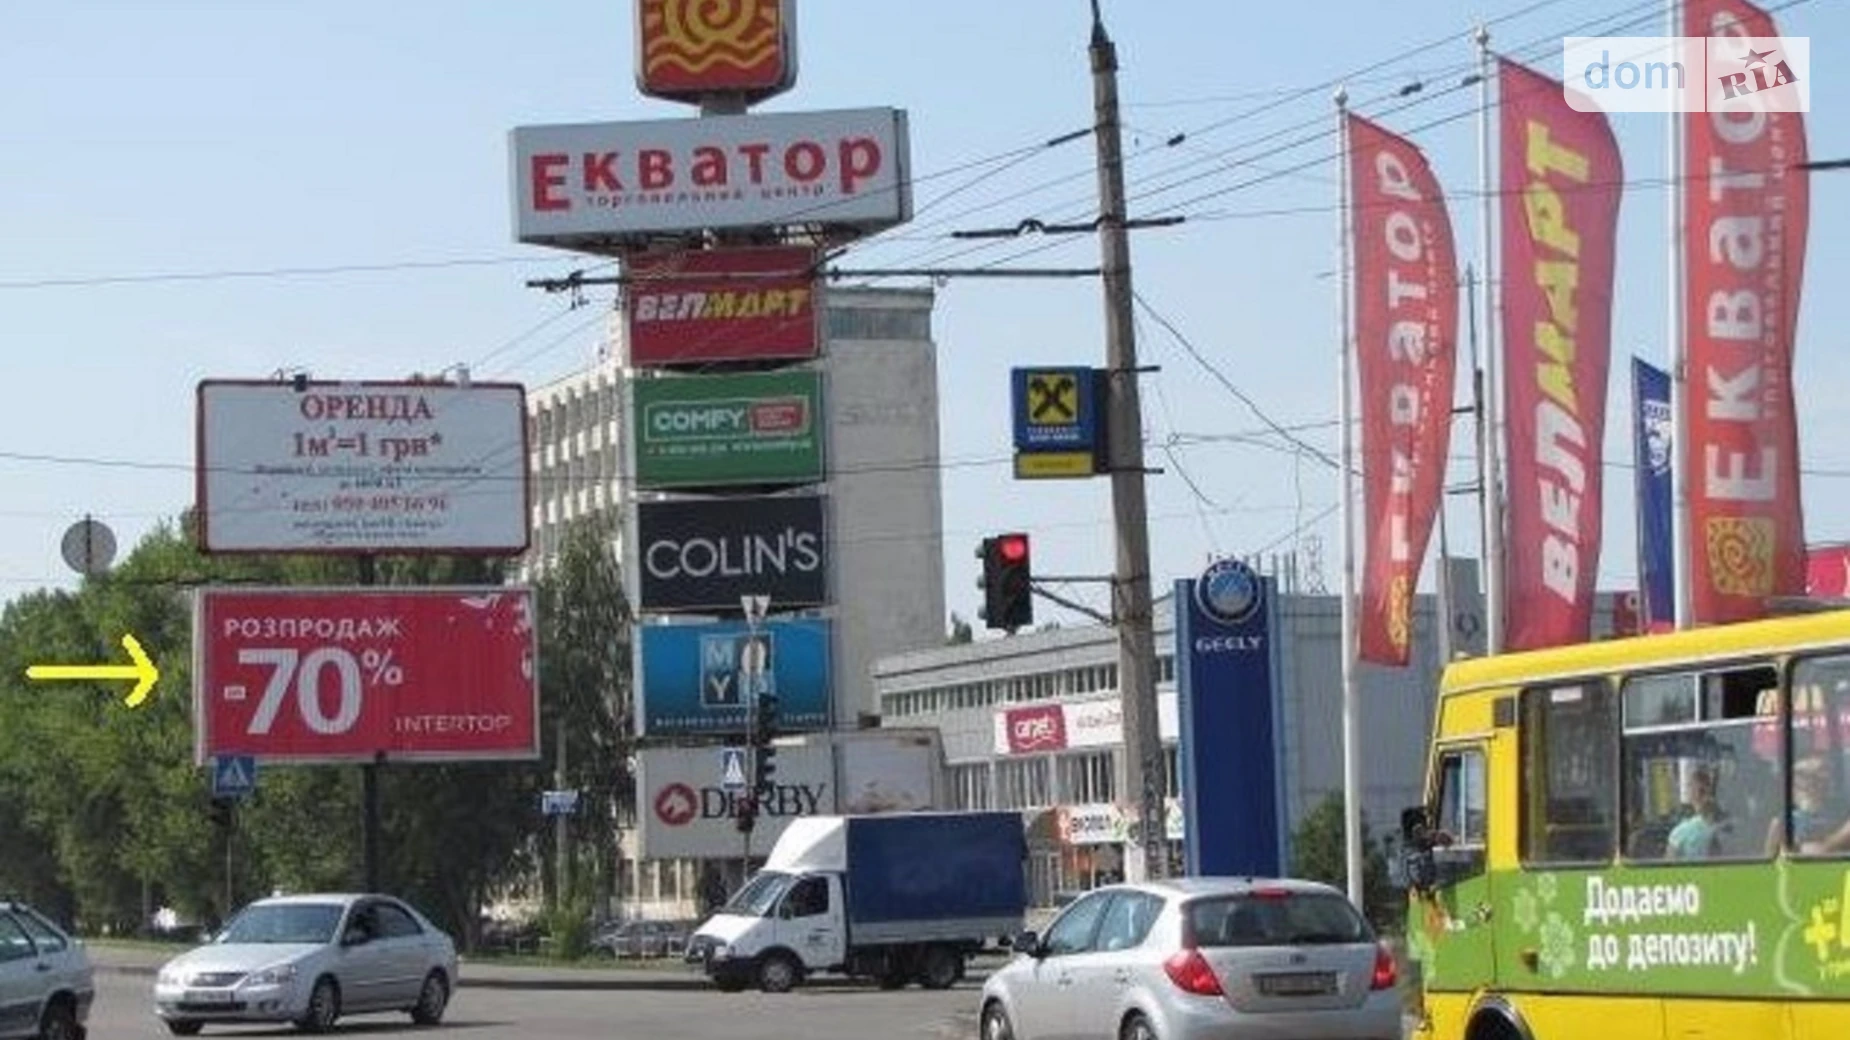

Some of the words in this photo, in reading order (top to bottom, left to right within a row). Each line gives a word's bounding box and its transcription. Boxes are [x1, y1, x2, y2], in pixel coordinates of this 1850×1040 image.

[300, 394, 435, 425] ОРЕНДА
[654, 408, 745, 431] COMFY
[646, 528, 819, 578] COLIN'S
[223, 617, 403, 640] РОЗПРОДАЖ
[1195, 636, 1263, 653] GEELY
[395, 714, 512, 734] INTERTOP
[1583, 875, 1700, 926] Додаємо
[1587, 933, 1619, 971] до
[1627, 919, 1758, 974] депозиту!
